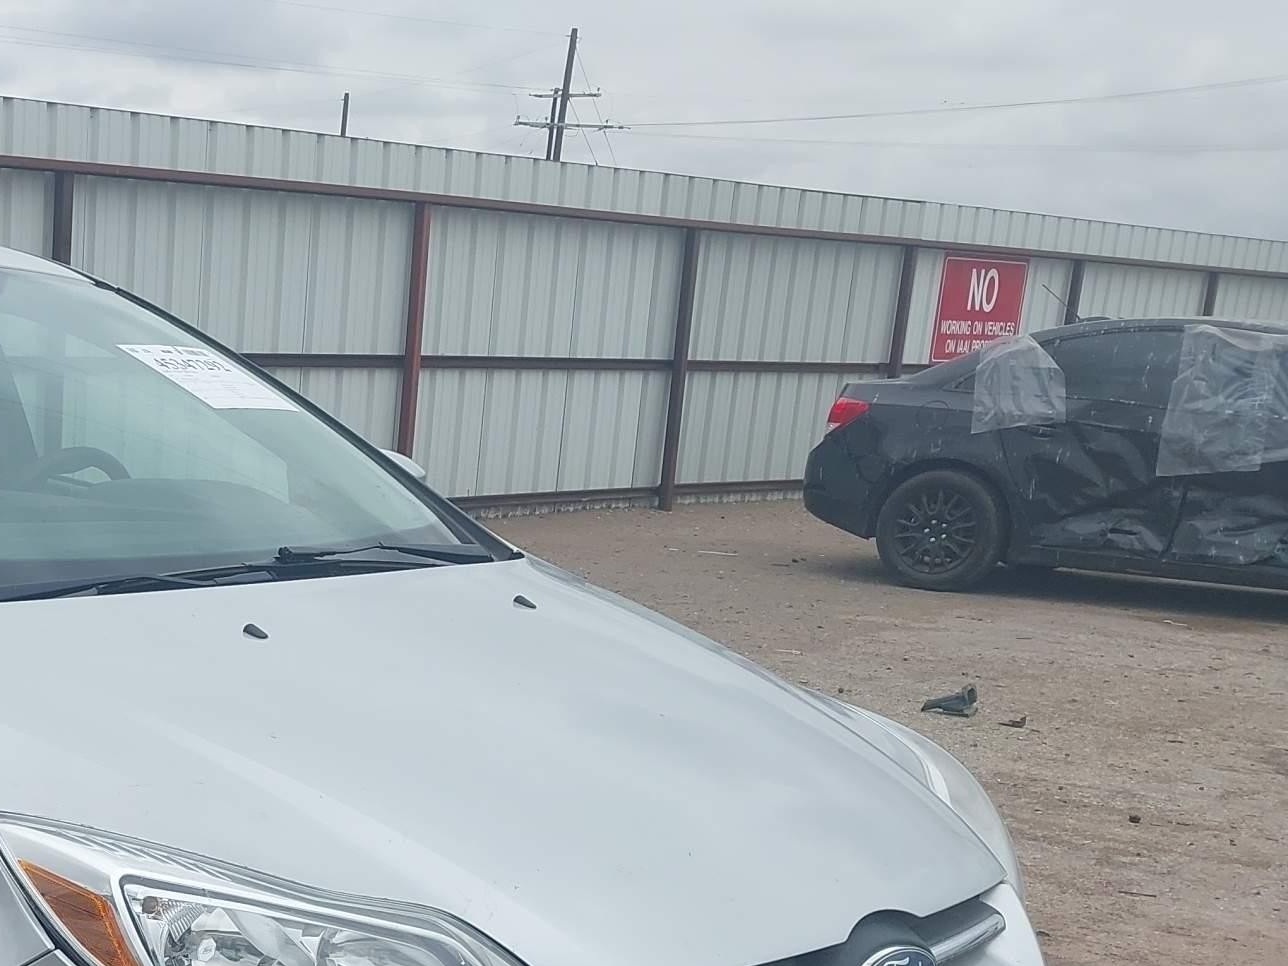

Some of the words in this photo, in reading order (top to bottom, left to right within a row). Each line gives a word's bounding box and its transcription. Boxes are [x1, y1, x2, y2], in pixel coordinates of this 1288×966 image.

[967, 268, 999, 313] NO
[940, 319, 972, 335] WORKING
[972, 320, 983, 335] ON
[984, 321, 1016, 337] VEHICLES
[945, 339, 956, 353] ON
